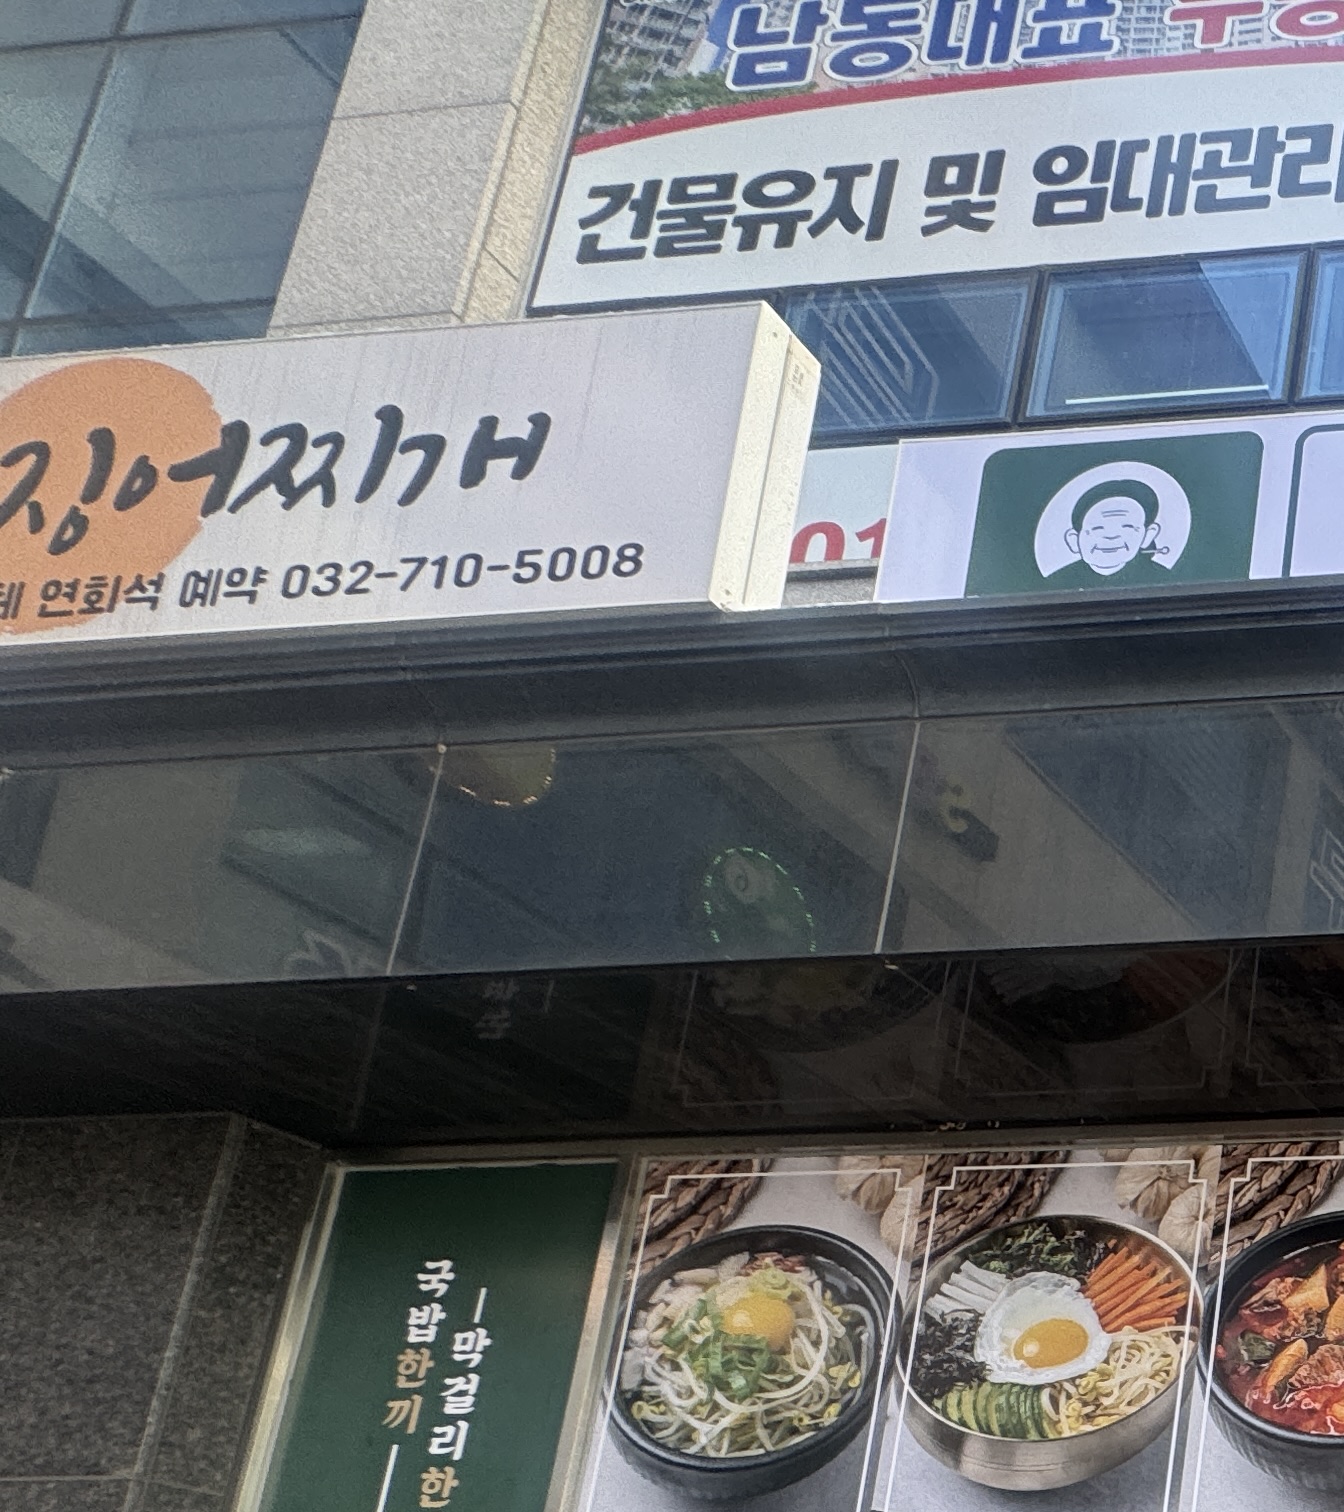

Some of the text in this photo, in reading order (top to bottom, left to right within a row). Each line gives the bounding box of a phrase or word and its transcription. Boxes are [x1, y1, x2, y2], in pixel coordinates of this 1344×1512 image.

[727, 0, 1119, 90] 남동대표
[575, 159, 900, 264] 건물유지
[921, 149, 1006, 237] 및
[38, 571, 166, 619] 연회석
[178, 564, 268, 608] 예약
[281, 542, 645, 600] 032-710-5008
